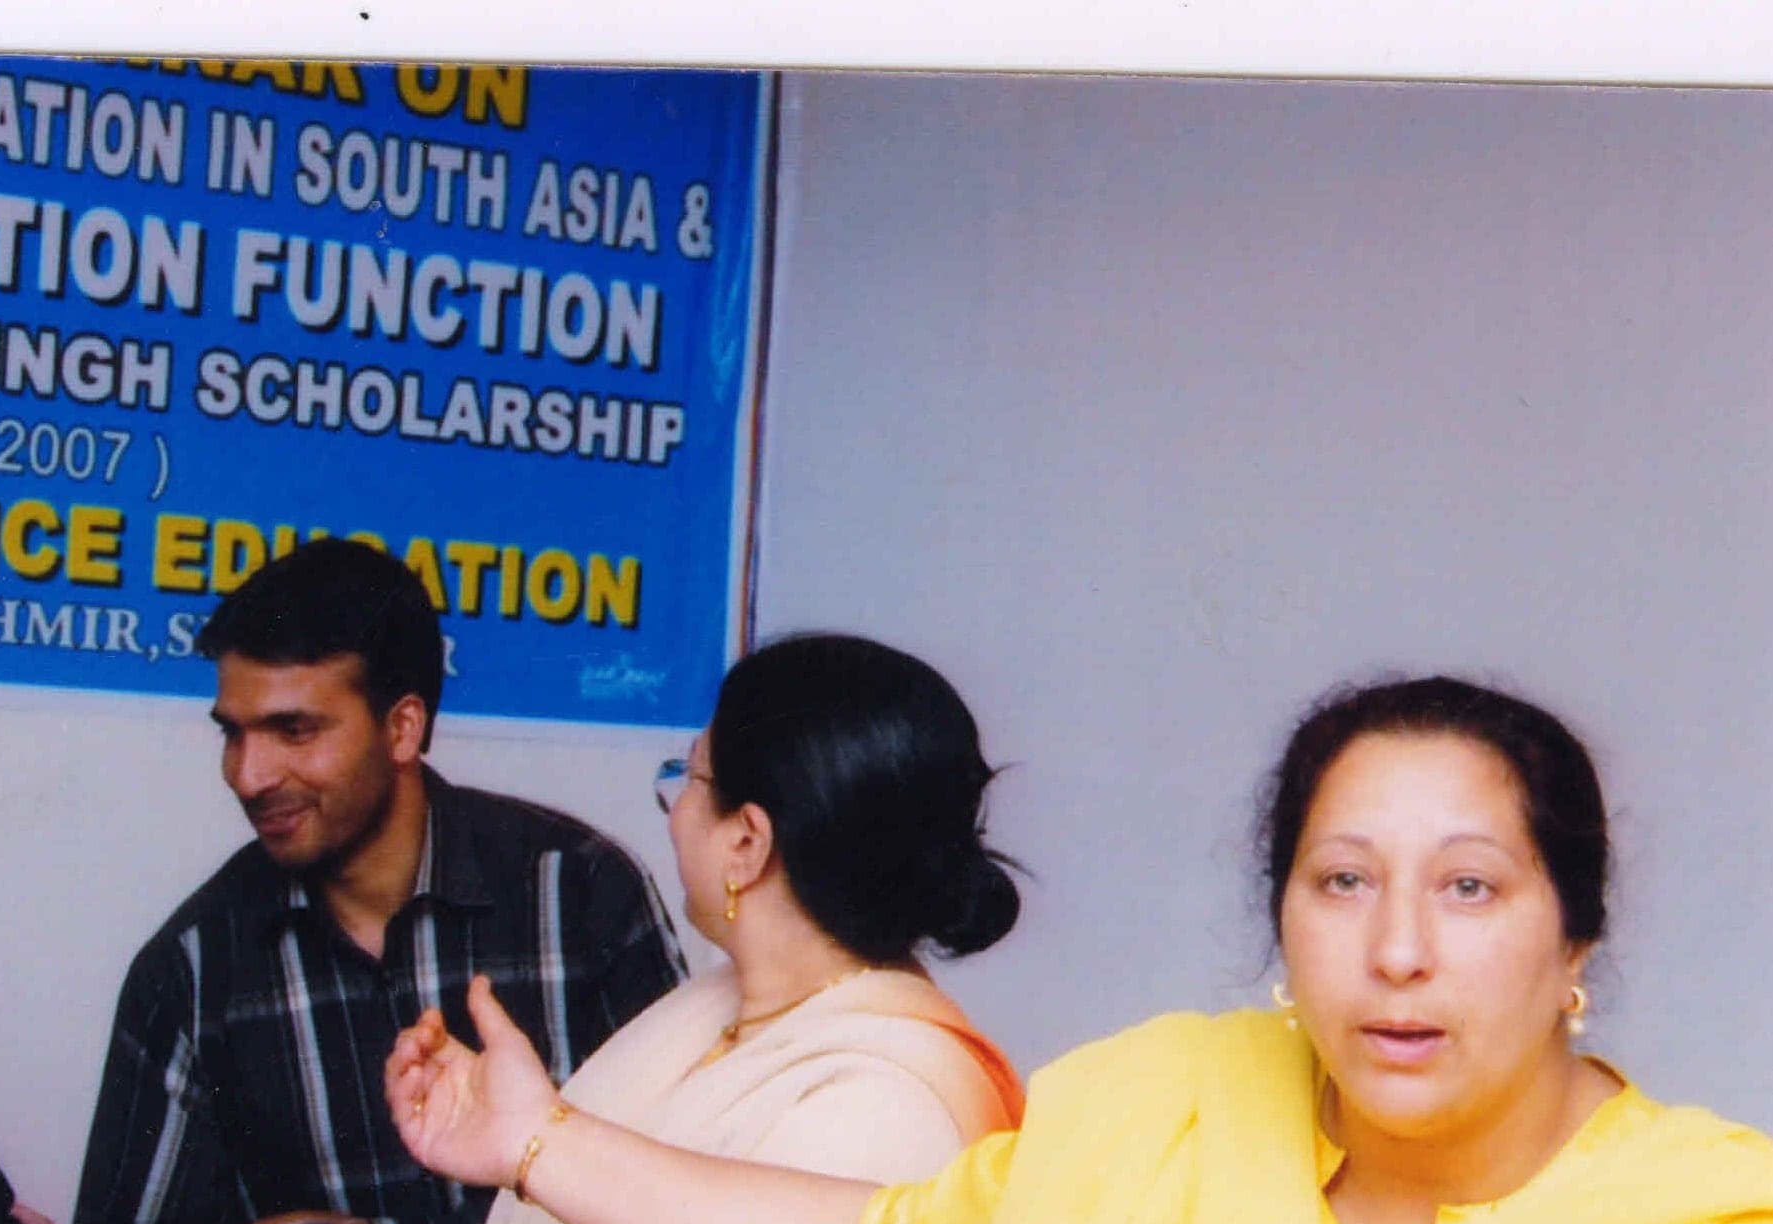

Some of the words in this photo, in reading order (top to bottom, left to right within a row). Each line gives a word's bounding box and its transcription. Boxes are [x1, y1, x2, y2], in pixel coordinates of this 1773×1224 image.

[396, 63, 529, 127] ON
[209, 114, 271, 193] IN
[297, 128, 503, 226] SOUTH
[528, 167, 656, 251] ASIA
[677, 183, 712, 259] &
[235, 233, 658, 369] FUNCTION
[199, 354, 684, 460] SCHOLARSHIP
